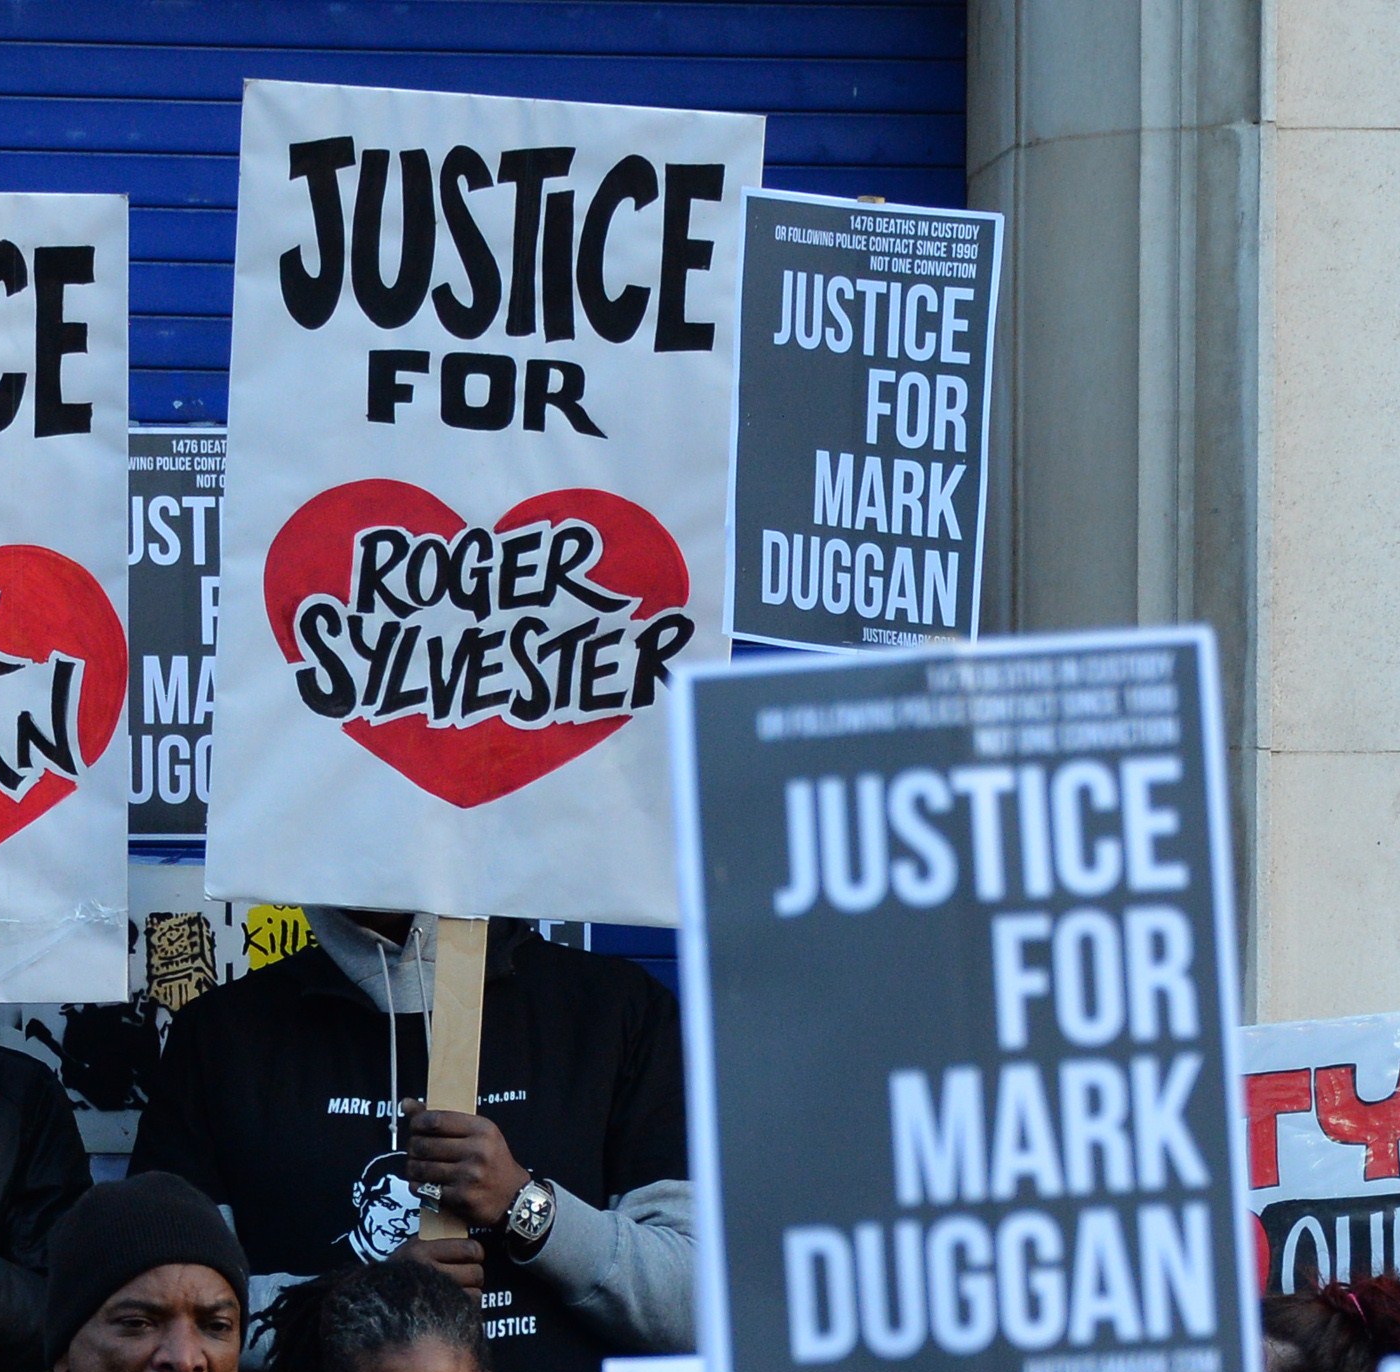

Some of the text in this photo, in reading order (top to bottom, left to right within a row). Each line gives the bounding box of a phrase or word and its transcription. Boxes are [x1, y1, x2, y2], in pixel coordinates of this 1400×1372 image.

[279, 136, 726, 352] JUSTICE
[775, 225, 979, 260] OR FOLLOWING POLICE CONTACT SINCE 1990
[850, 215, 980, 241] 1476 DEATHS IN CUSTODY
[870, 255, 977, 279] NOT ONE CONVICTION
[773, 270, 975, 365] JUSTICE
[367, 350, 608, 438] FOR
[865, 368, 968, 453] FOR
[156, 457, 192, 471] POLICE
[171, 440, 198, 454] 1476
[196, 474, 217, 489] NOT
[813, 449, 967, 541] MARK
[356, 526, 630, 618] ROGER
[761, 529, 959, 628] DUGGAN
[295, 602, 696, 725] SYLVESTER
[775, 756, 1189, 917] JUSTICE
[992, 905, 1201, 1050] FOR
[328, 1098, 370, 1116] MARK
[889, 1053, 1211, 1206] MARK
[783, 1204, 1218, 1367] DUGGAN
